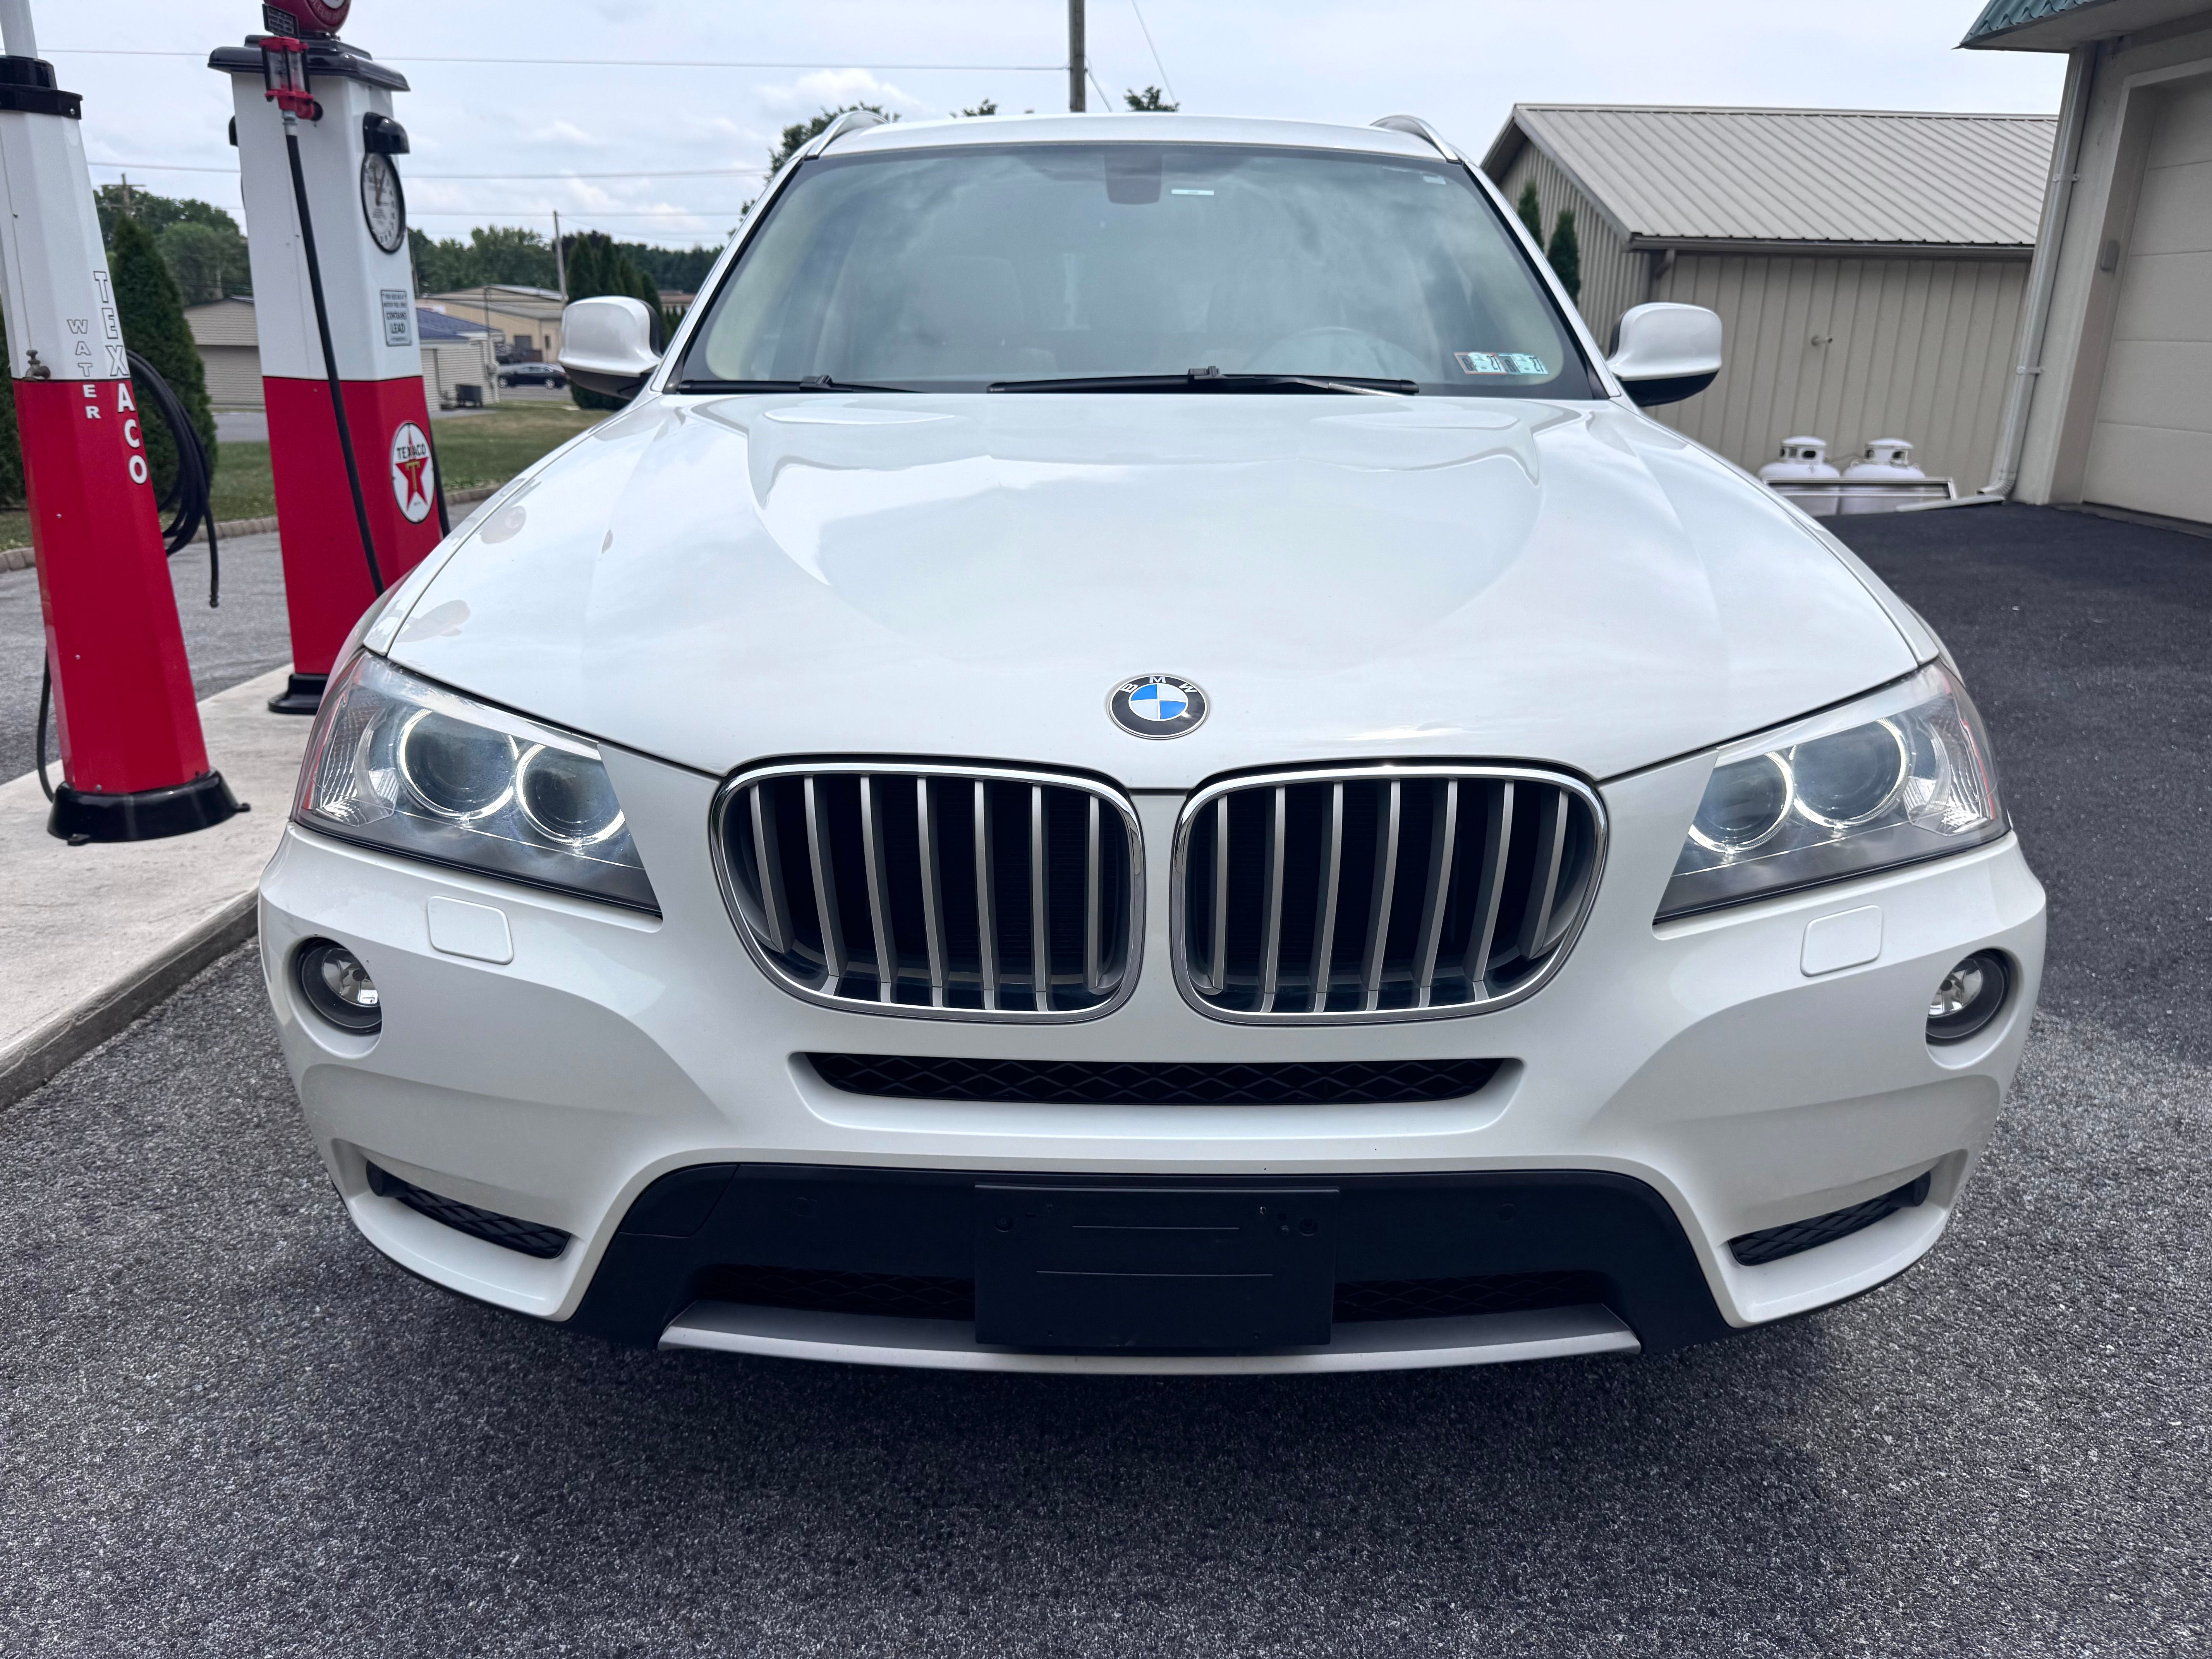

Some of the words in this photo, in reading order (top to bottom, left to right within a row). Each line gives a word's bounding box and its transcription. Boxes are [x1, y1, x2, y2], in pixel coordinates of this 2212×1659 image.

[391, 323, 405, 334] LEAD
[67, 319, 101, 419] WATER
[93, 271, 148, 484] TEXACO
[397, 443, 426, 459] TEXACO
[405, 460, 421, 492] T
[1120, 677, 1198, 694] BMW
